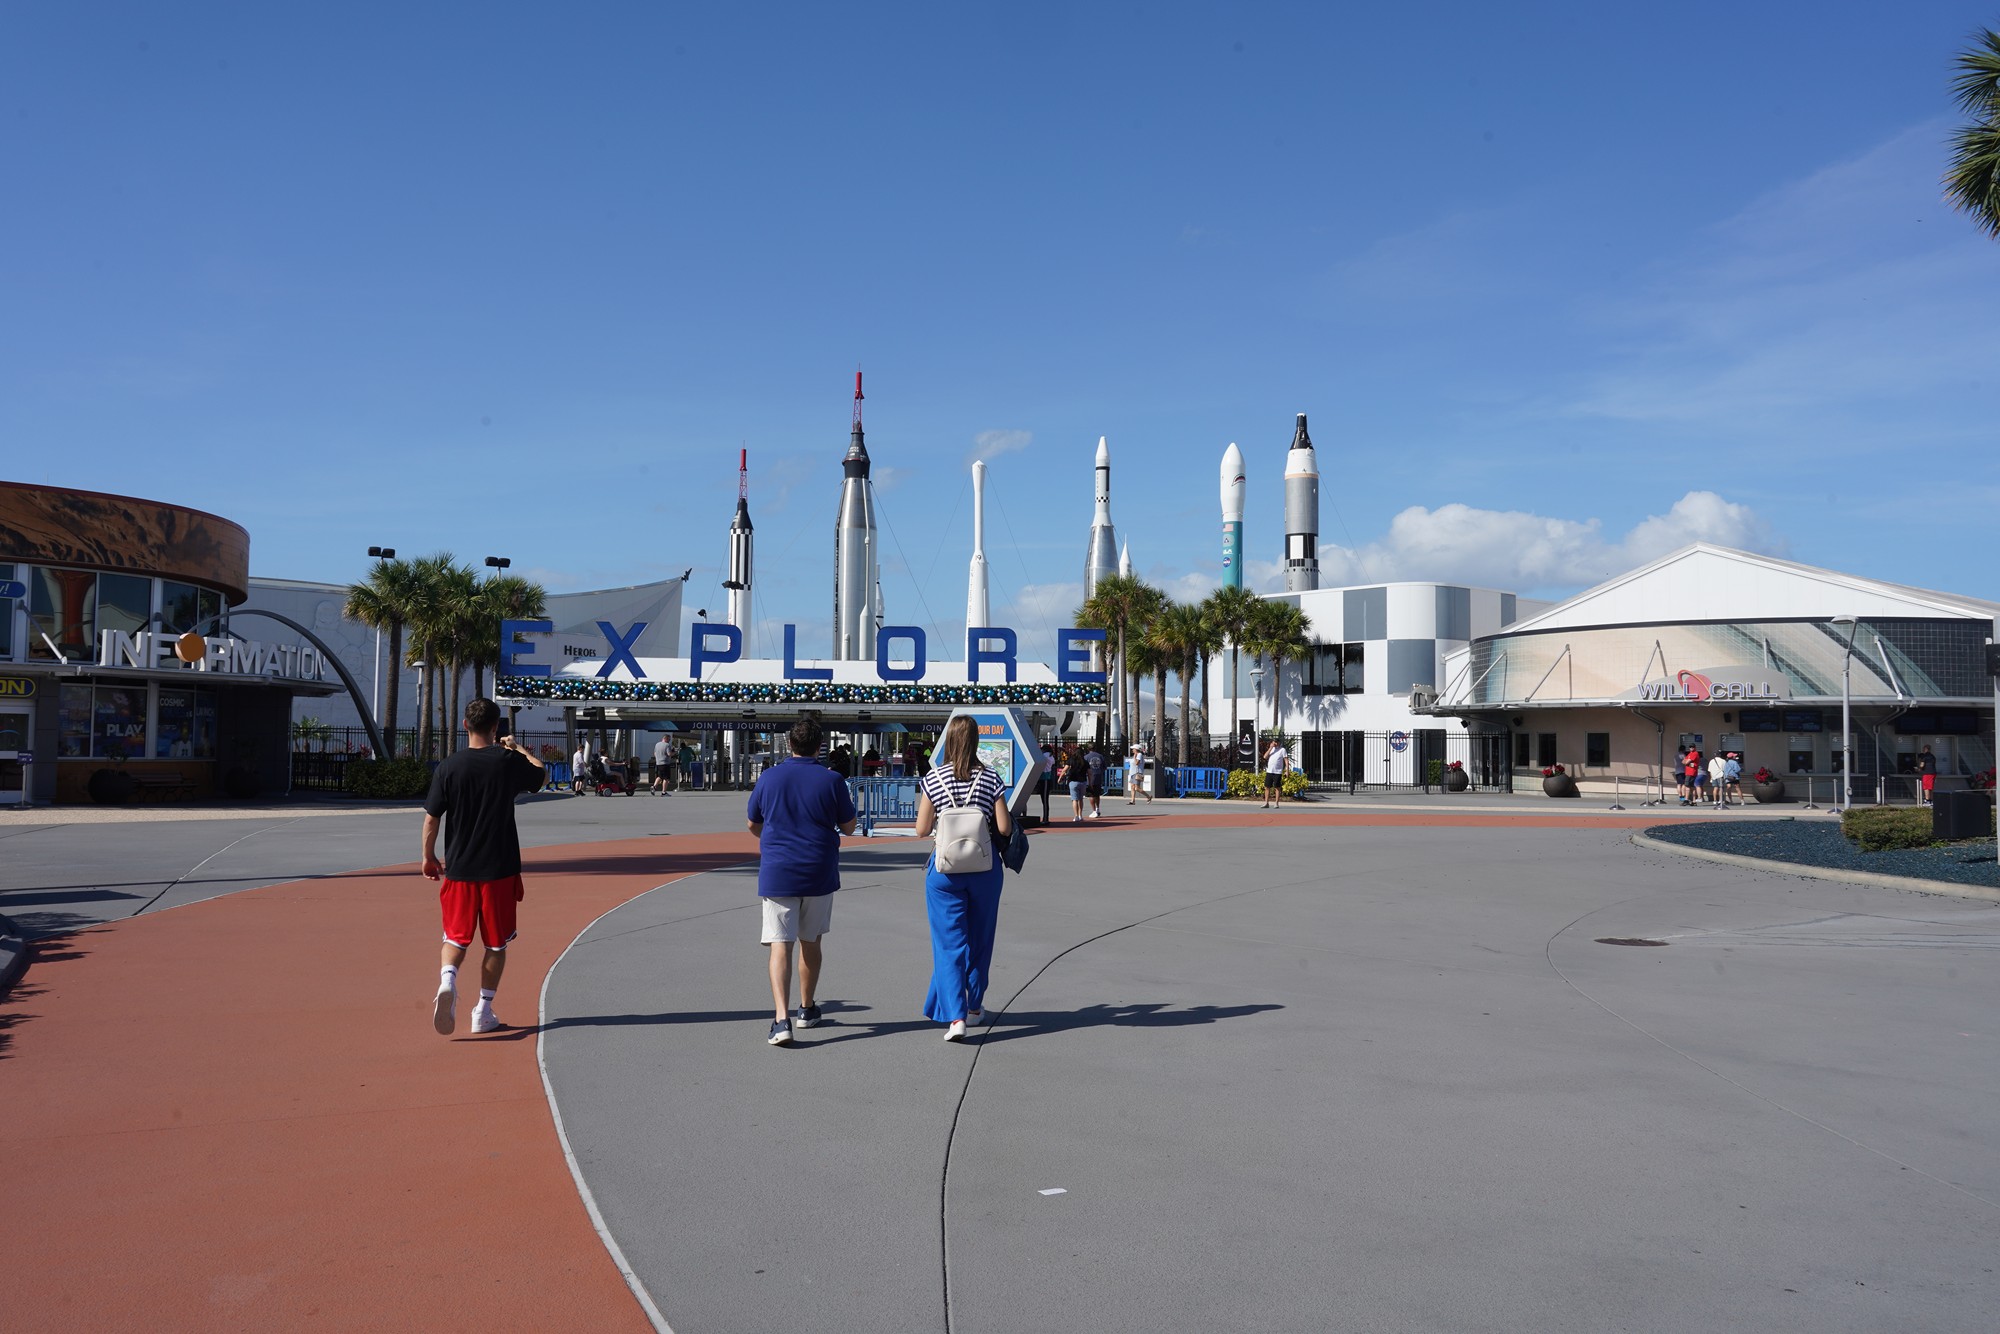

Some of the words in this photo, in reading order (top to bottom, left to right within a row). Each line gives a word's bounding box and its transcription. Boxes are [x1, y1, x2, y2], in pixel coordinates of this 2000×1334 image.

[101, 629, 326, 681] INFORMATION
[500, 620, 1107, 683] EXPLORE
[1637, 683, 1699, 699] WILL
[1709, 682, 1778, 699] CALL
[159, 698, 185, 707] COSMIC
[106, 723, 144, 737] PLAY
[717, 722, 733, 730] THE
[737, 722, 777, 730] JOURNEY
[922, 724, 942, 732] JOIN
[977, 725, 990, 735] OUR
[991, 725, 1005, 735] DAY
